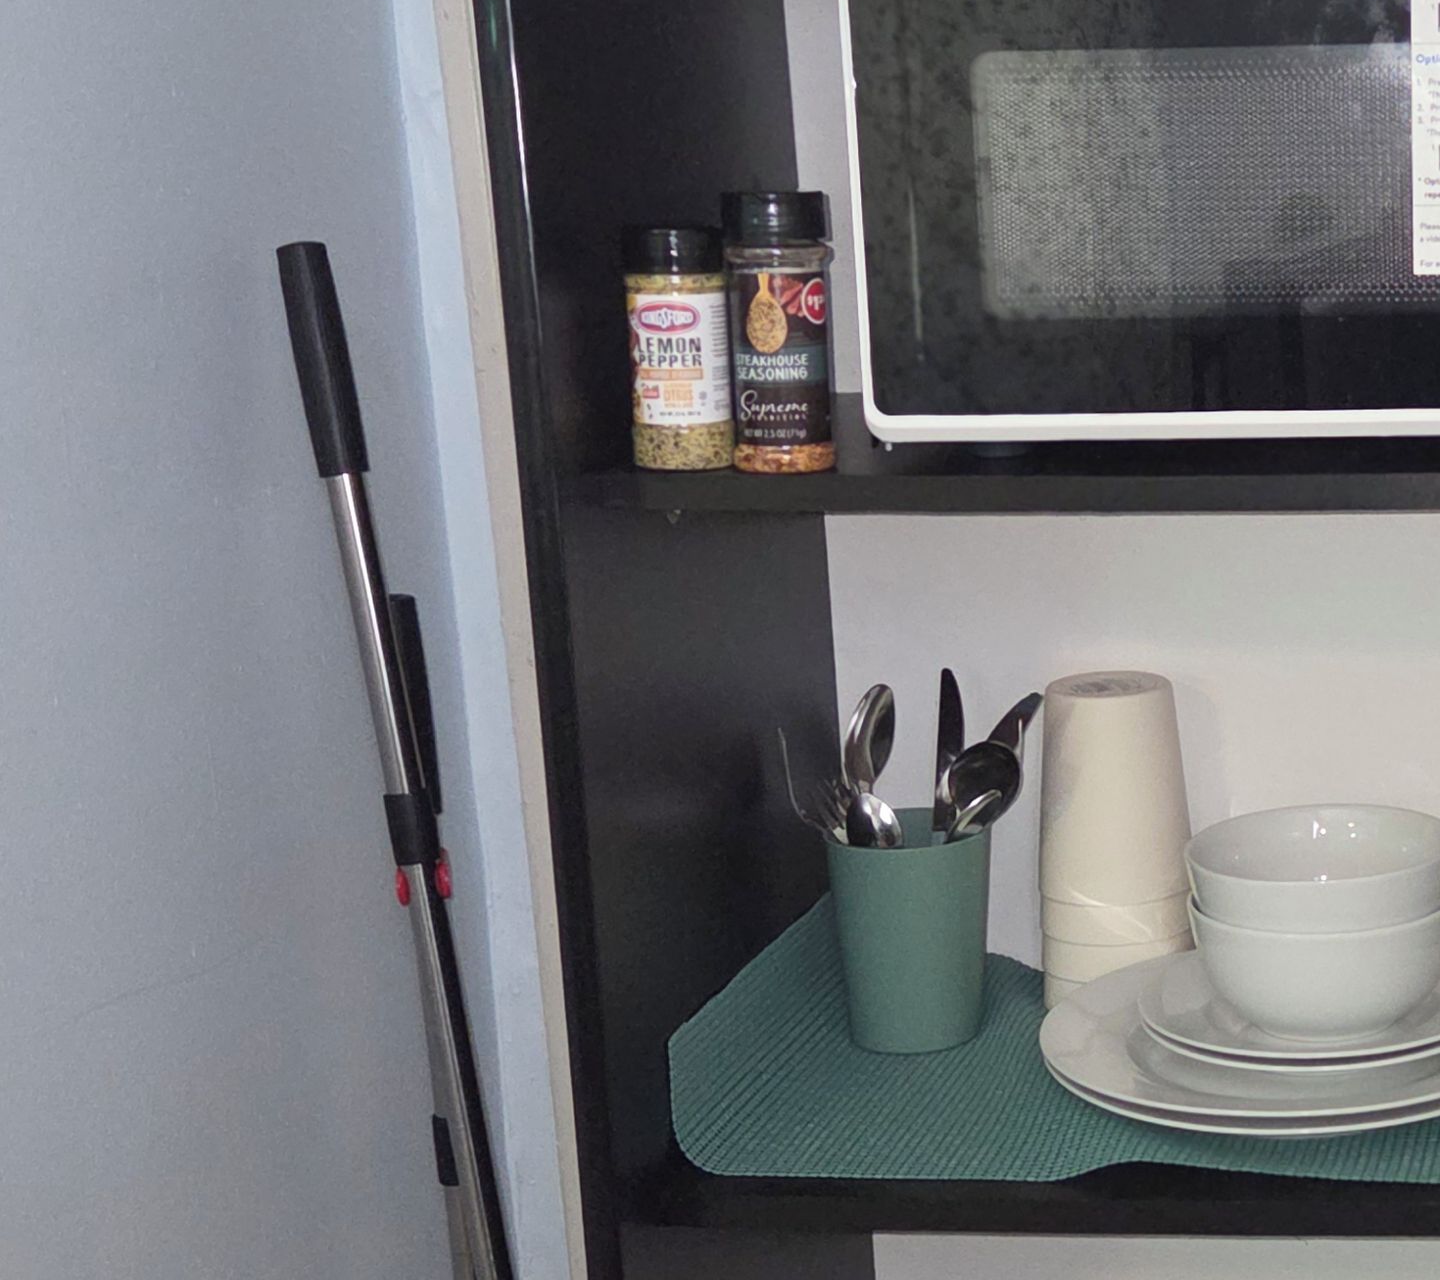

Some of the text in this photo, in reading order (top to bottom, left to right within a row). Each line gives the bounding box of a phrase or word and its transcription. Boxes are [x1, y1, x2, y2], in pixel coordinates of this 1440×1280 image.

[638, 337, 702, 354] LEMON
[638, 353, 703, 368] PEPPER
[736, 352, 809, 367] STEAKHOUSE
[736, 368, 809, 381] SEASONING
[740, 389, 809, 421] Supreme
